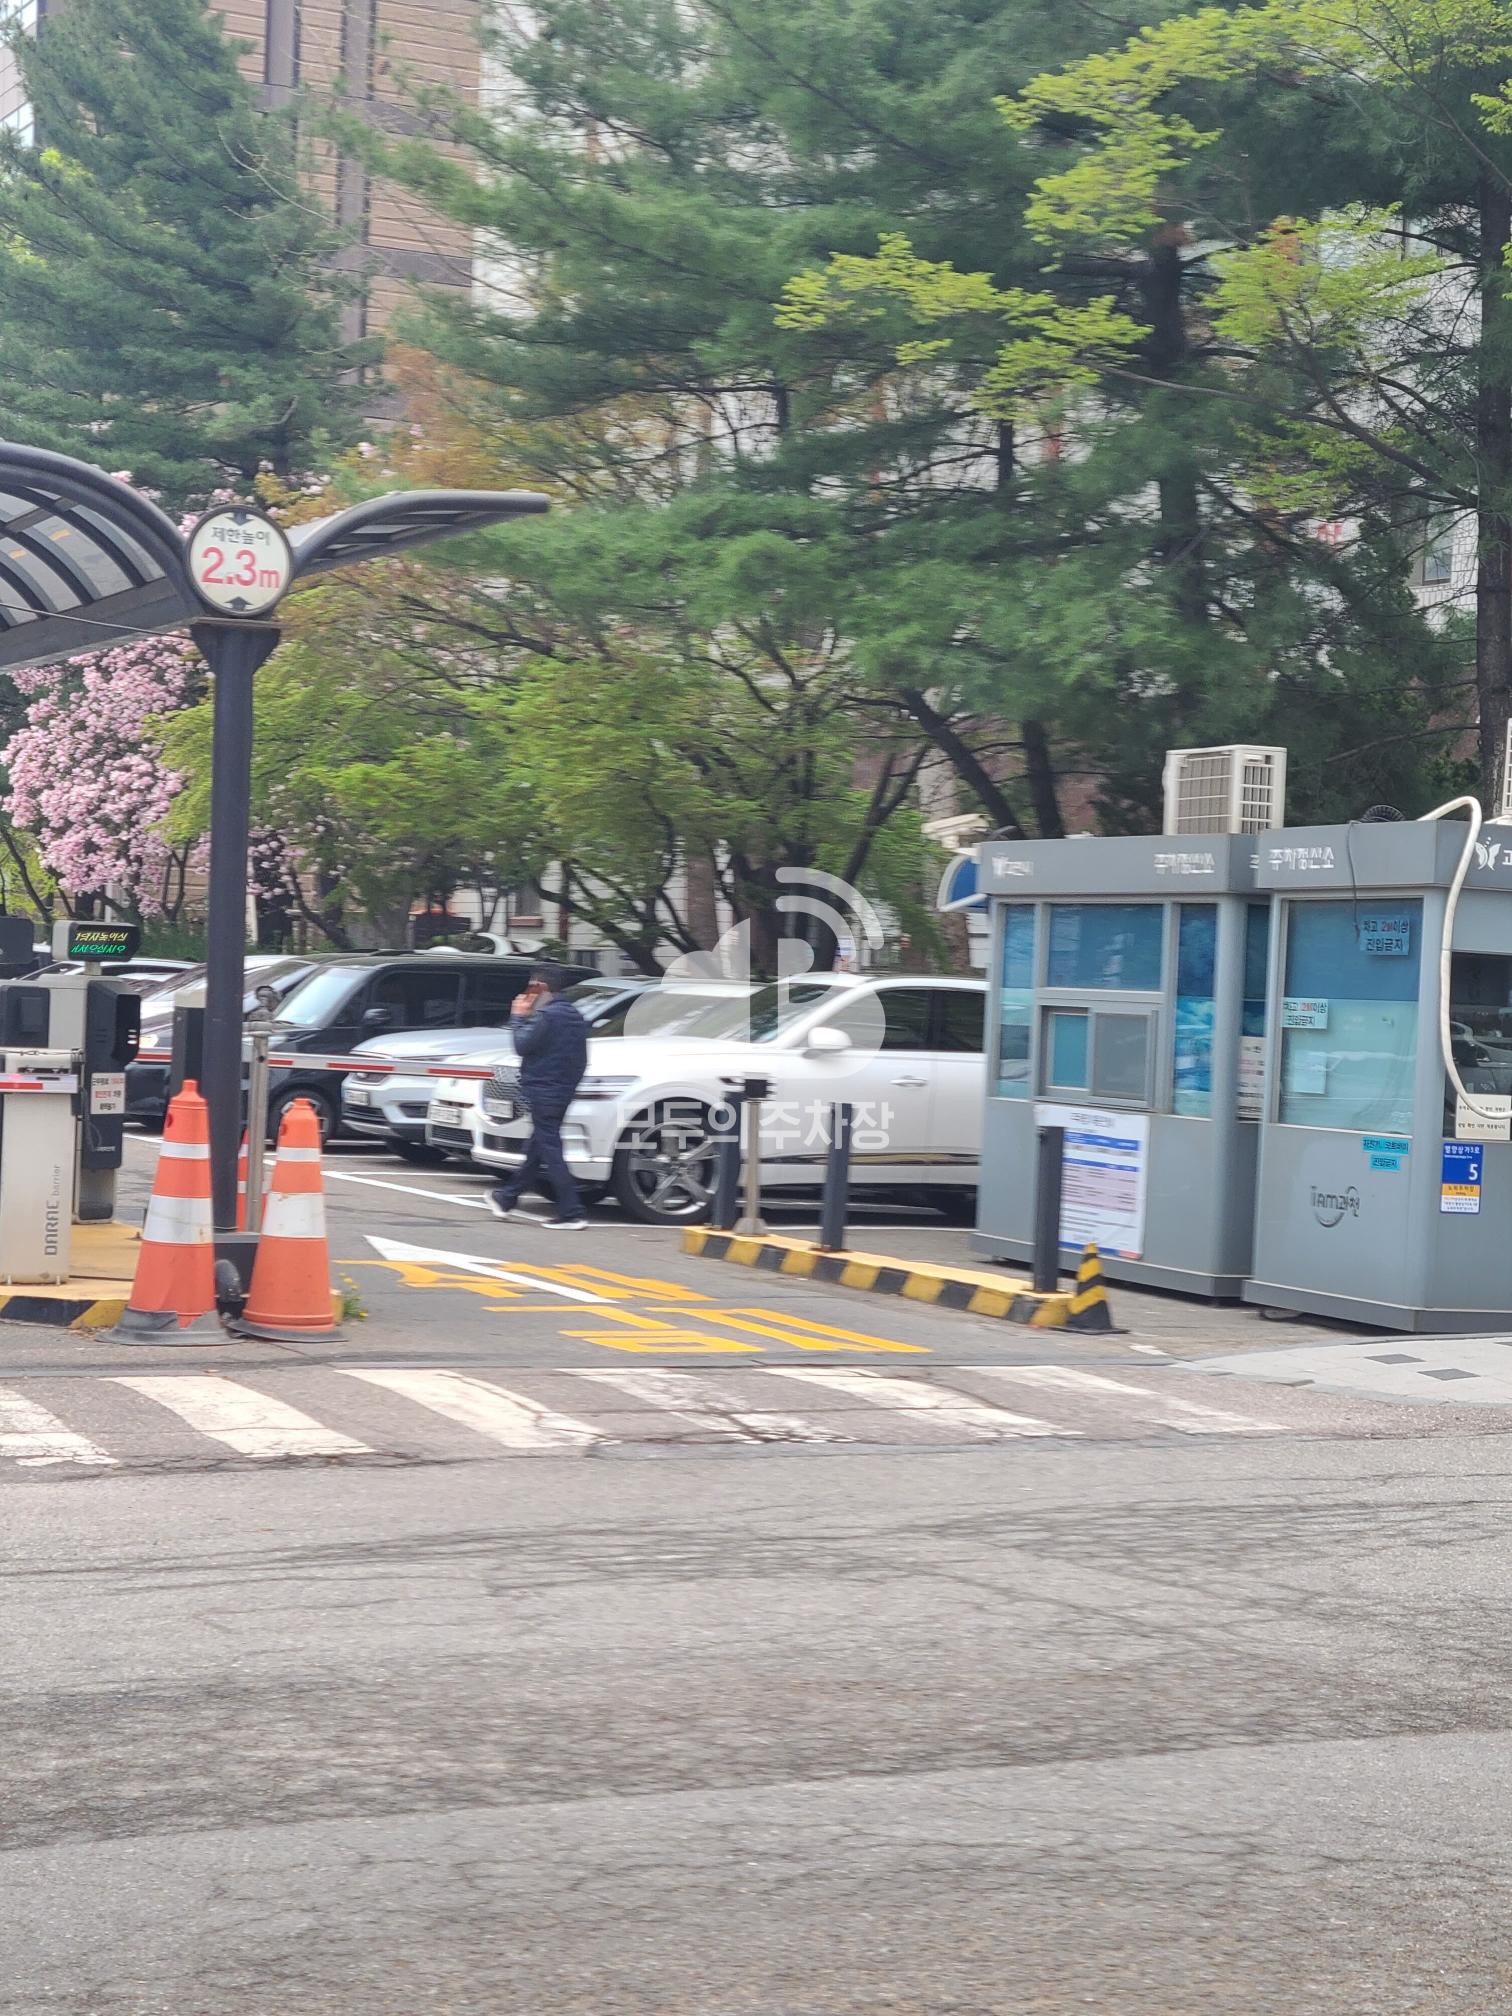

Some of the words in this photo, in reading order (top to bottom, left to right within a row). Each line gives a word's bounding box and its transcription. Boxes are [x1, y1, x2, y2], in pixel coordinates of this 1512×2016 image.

[210, 526, 271, 546] 제한높이
[201, 546, 279, 588] 2.3m
[1268, 847, 1335, 871] 주차정산소
[1366, 938, 1404, 952] 진입금지
[52, 1165, 61, 1197] barrier
[1468, 1163, 1479, 1181] 5
[482, 1304, 933, 1353] 금지
